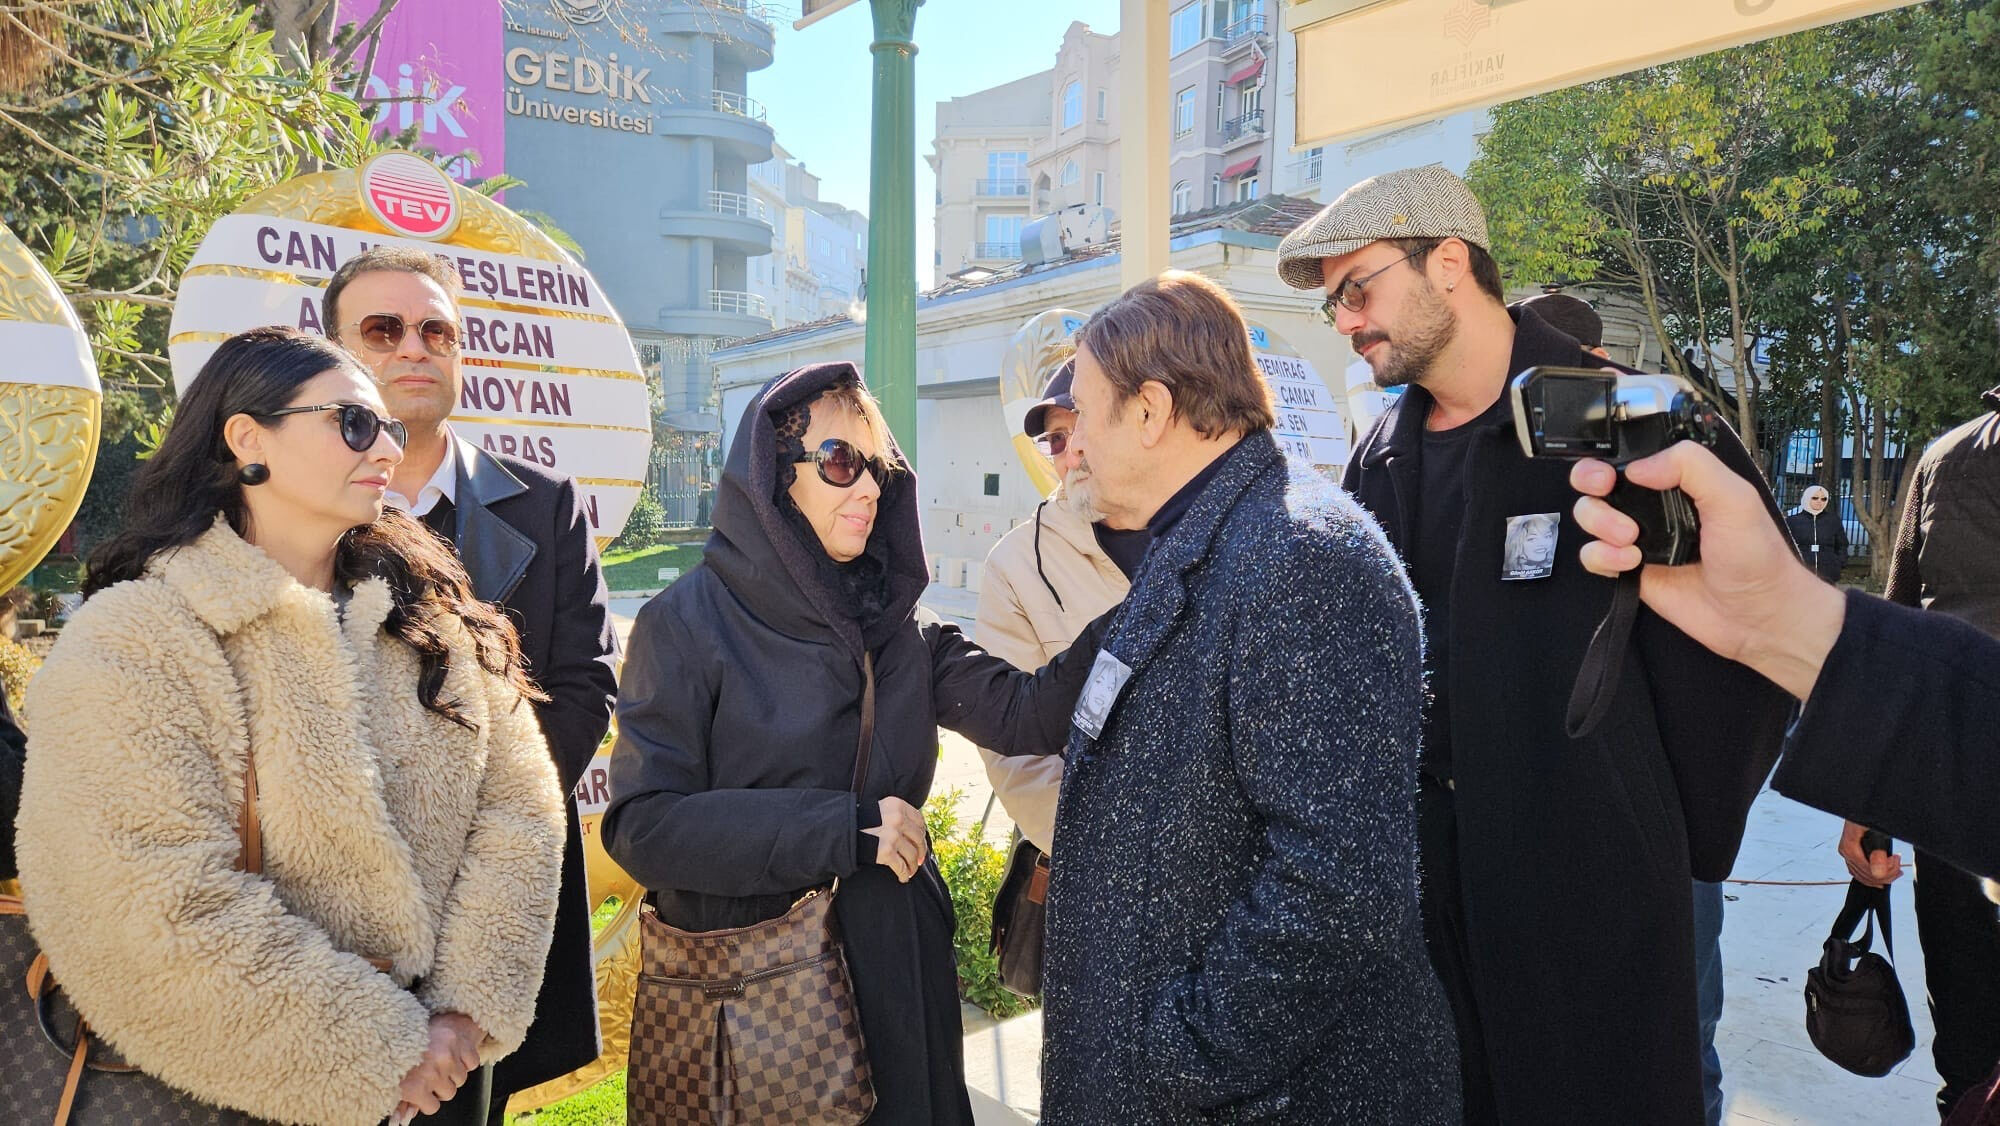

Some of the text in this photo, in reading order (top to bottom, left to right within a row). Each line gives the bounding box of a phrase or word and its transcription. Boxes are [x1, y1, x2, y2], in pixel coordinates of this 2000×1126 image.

[505, 47, 651, 104] GEDİK
[506, 86, 653, 134] Üniversitesi
[377, 193, 447, 223] TEV
[257, 226, 337, 272] CAN
[459, 316, 555, 359] RCAN
[461, 375, 572, 417] NOYAN
